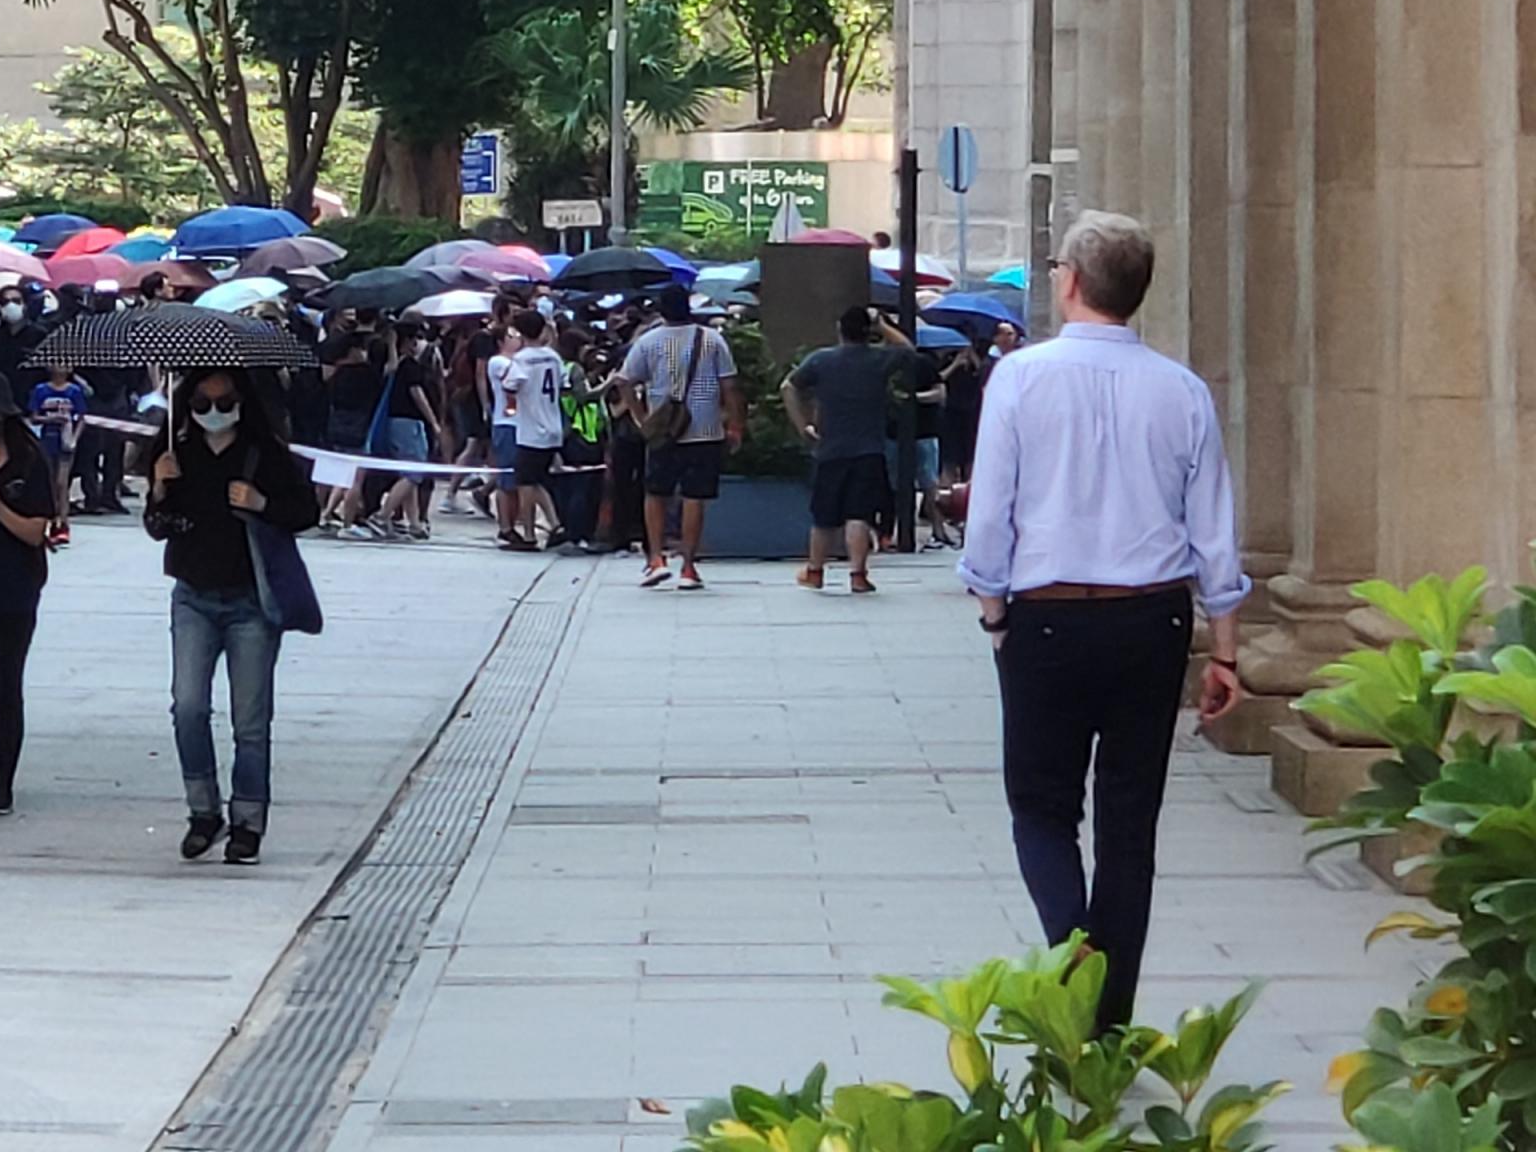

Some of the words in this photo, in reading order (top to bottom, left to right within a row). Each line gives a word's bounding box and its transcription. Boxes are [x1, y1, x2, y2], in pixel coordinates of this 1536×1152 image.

[729, 169, 772, 185] FREE
[774, 168, 825, 191] Parking
[766, 188, 781, 206] 6
[542, 368, 555, 403] 4
